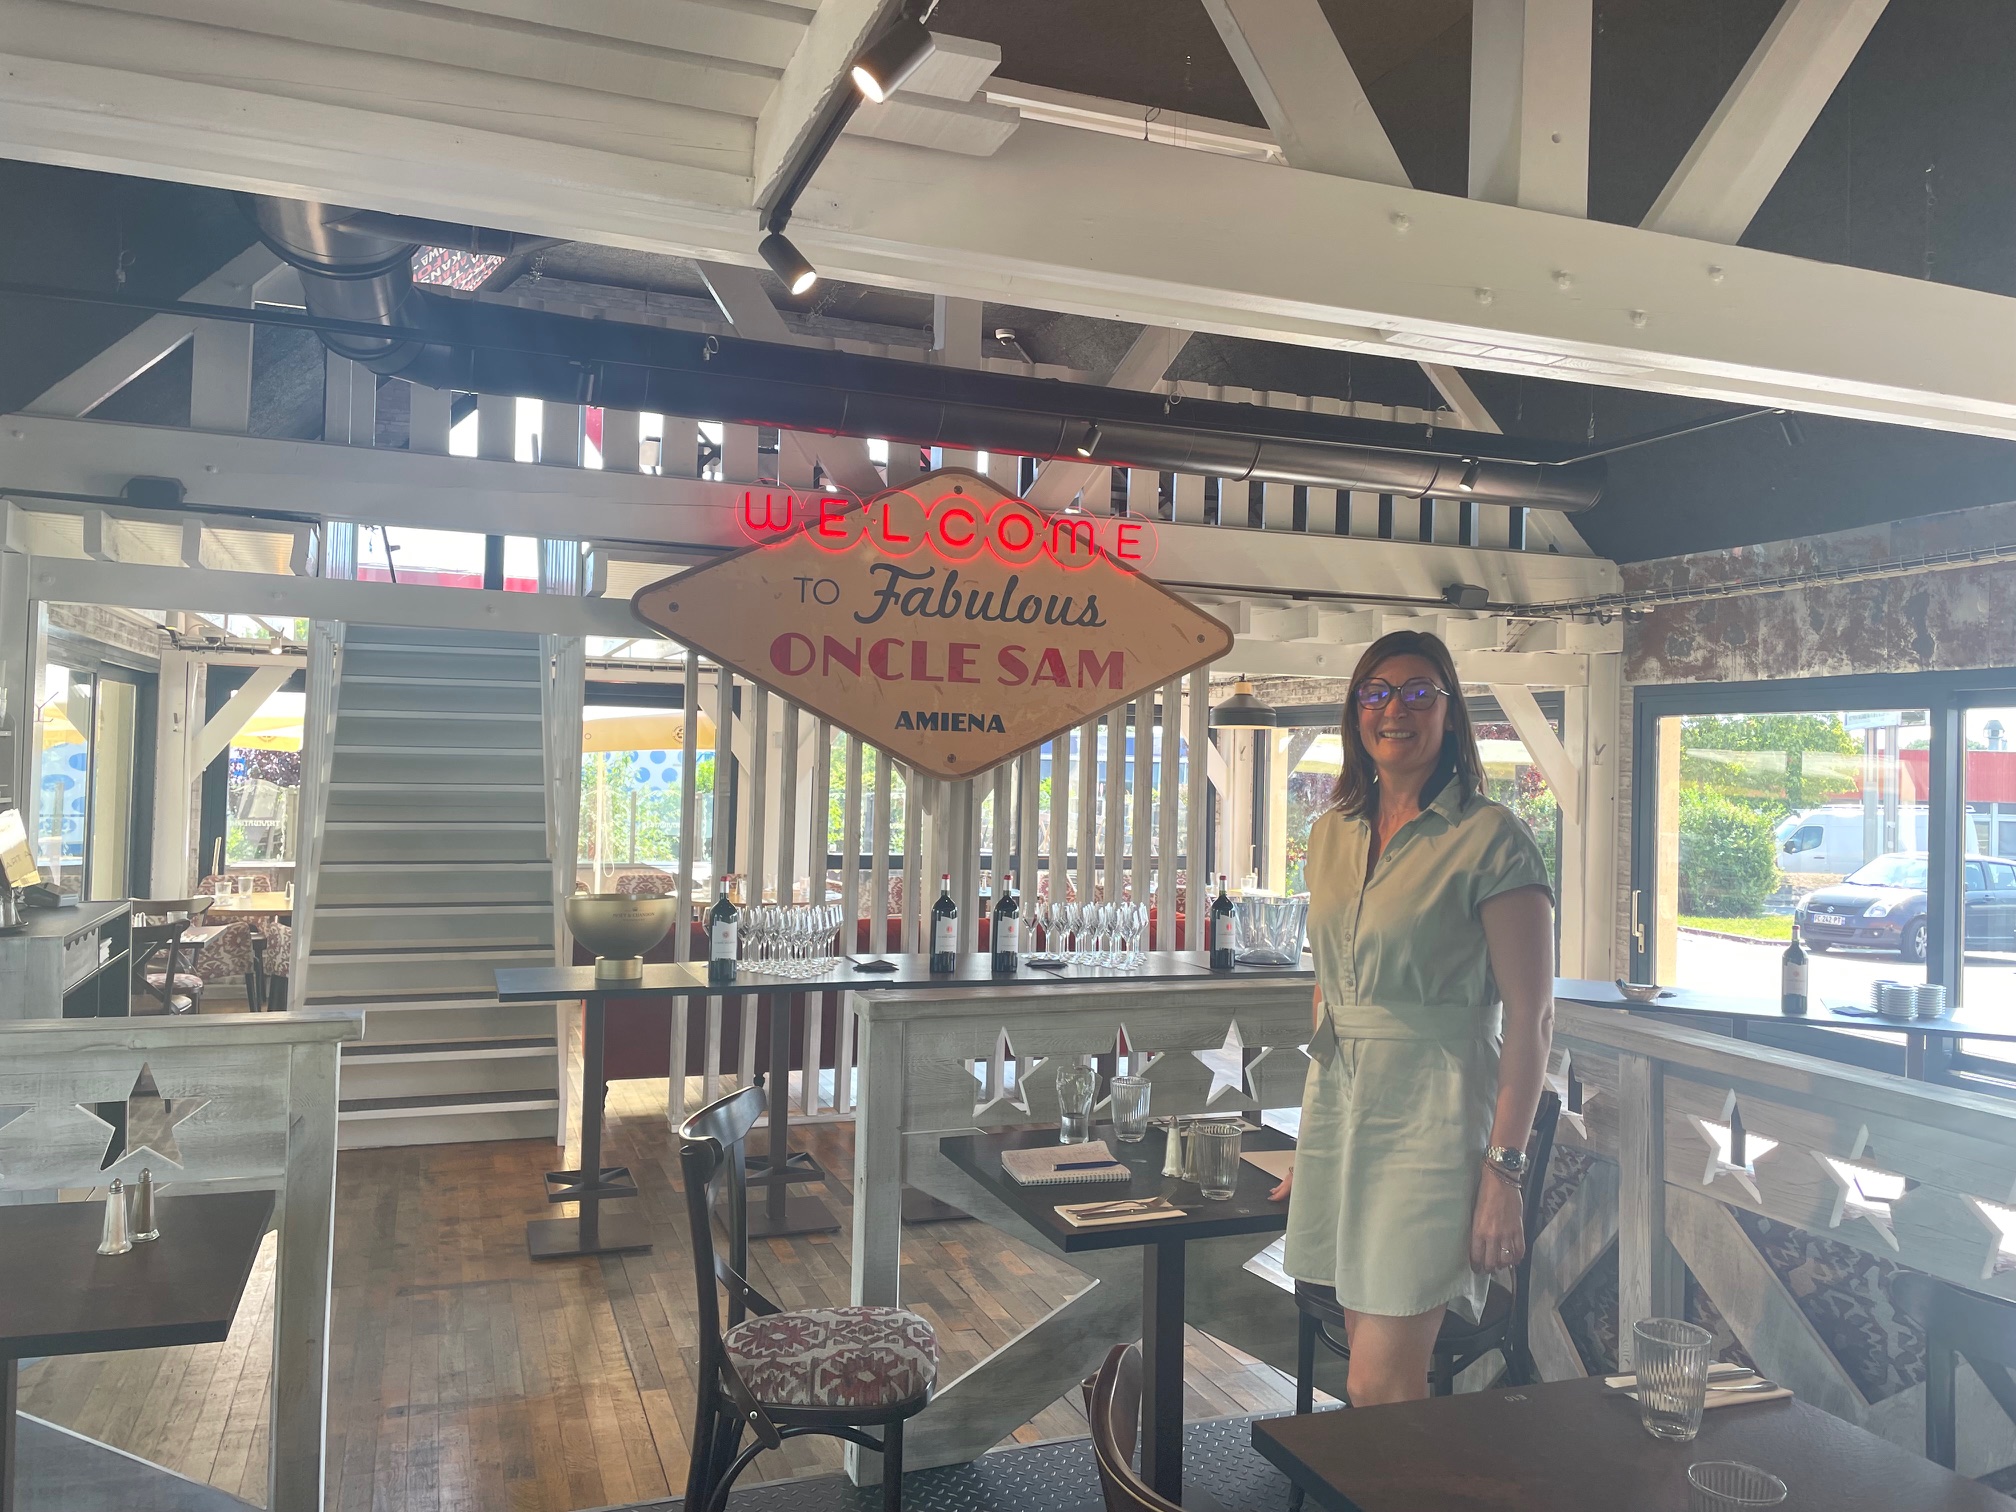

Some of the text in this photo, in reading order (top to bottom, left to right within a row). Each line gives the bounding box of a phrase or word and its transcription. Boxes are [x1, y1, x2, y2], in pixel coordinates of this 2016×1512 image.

[745, 491, 1142, 559] WELCOME
[793, 562, 1107, 628] TO Fabulous
[769, 632, 1124, 690] ONCLE SAM
[894, 710, 1006, 733] AMIENA
